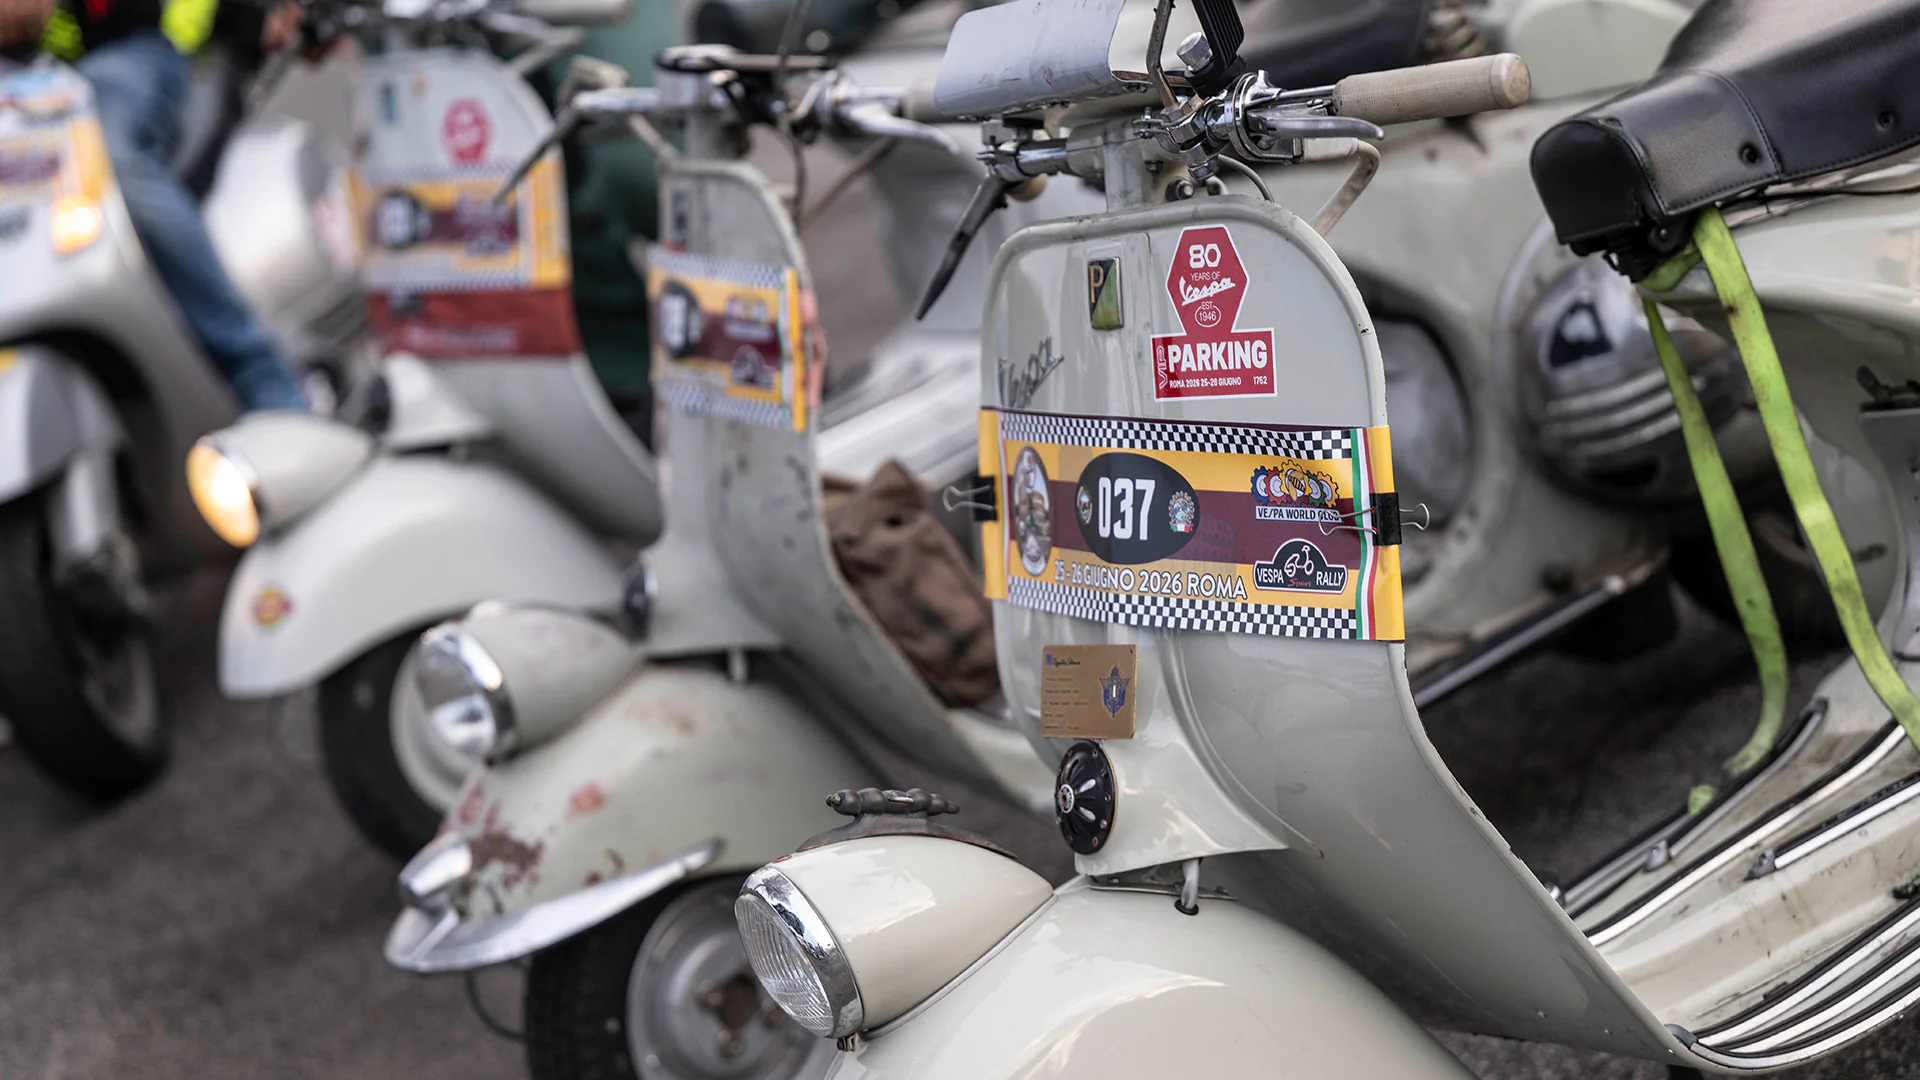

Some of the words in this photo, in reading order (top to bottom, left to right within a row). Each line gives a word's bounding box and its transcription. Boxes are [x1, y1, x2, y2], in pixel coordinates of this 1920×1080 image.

[1189, 243, 1222, 269] 80
[1088, 265, 1104, 304] P
[1190, 271, 1210, 281] YEARS
[1211, 270, 1221, 280] OF
[1178, 276, 1236, 306] Vespa
[1199, 309, 1217, 322] 1946
[1157, 345, 1169, 390] VIP
[1167, 340, 1268, 373] PARKING
[1169, 379, 1185, 389] ROMA
[1185, 378, 1200, 388] 2026
[1200, 377, 1218, 387] 25-28
[1218, 376, 1242, 386] GIUGNO
[1253, 376, 1268, 385] 1752
[1098, 476, 1156, 541] 037
[1285, 508, 1316, 520] WORLD
[1318, 510, 1340, 521] CLUB
[1054, 559, 1065, 582] 25
[1071, 561, 1083, 585] 26
[1083, 564, 1135, 592] GIUGNO
[1138, 570, 1183, 596] 2026
[1186, 572, 1248, 600] ROMA
[1256, 567, 1284, 584] VESPA
[1316, 571, 1345, 587] RALLY
[1287, 578, 1312, 588] Sport
